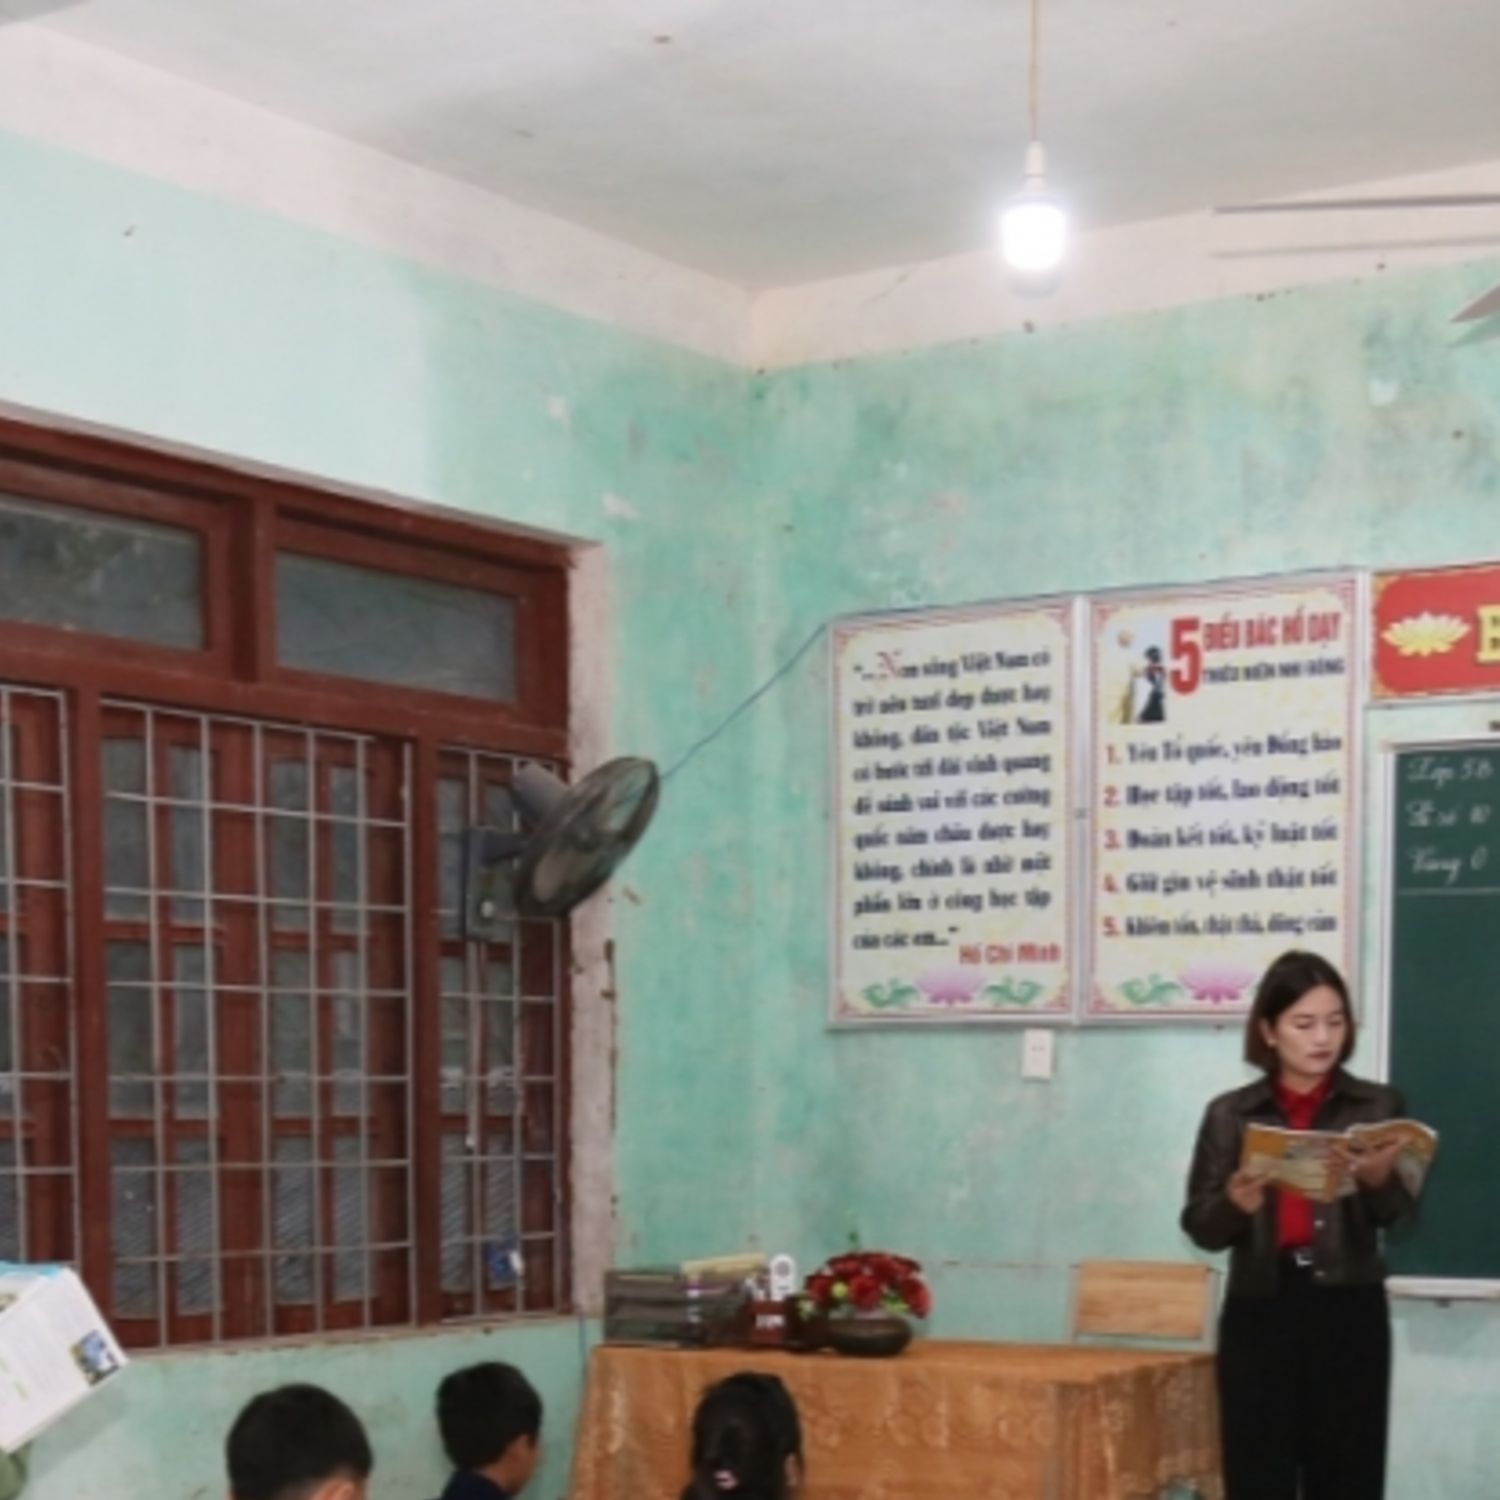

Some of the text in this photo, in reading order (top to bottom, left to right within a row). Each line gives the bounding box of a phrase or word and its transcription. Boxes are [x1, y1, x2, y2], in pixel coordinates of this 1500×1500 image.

[1169, 617, 1201, 695] 5
[1246, 613, 1277, 648] BÁC
[1282, 603, 1305, 645] HỒ
[1308, 612, 1342, 649] DẠY
[962, 652, 992, 673] Việt
[996, 652, 1029, 668] Nam
[1105, 745, 1122, 764] 1.
[1103, 785, 1121, 808] 2.
[1103, 829, 1121, 850] 3.
[1103, 873, 1120, 893] 4.
[1103, 916, 1120, 937] 5.
[960, 942, 1061, 964] Hồ Chí Minh
